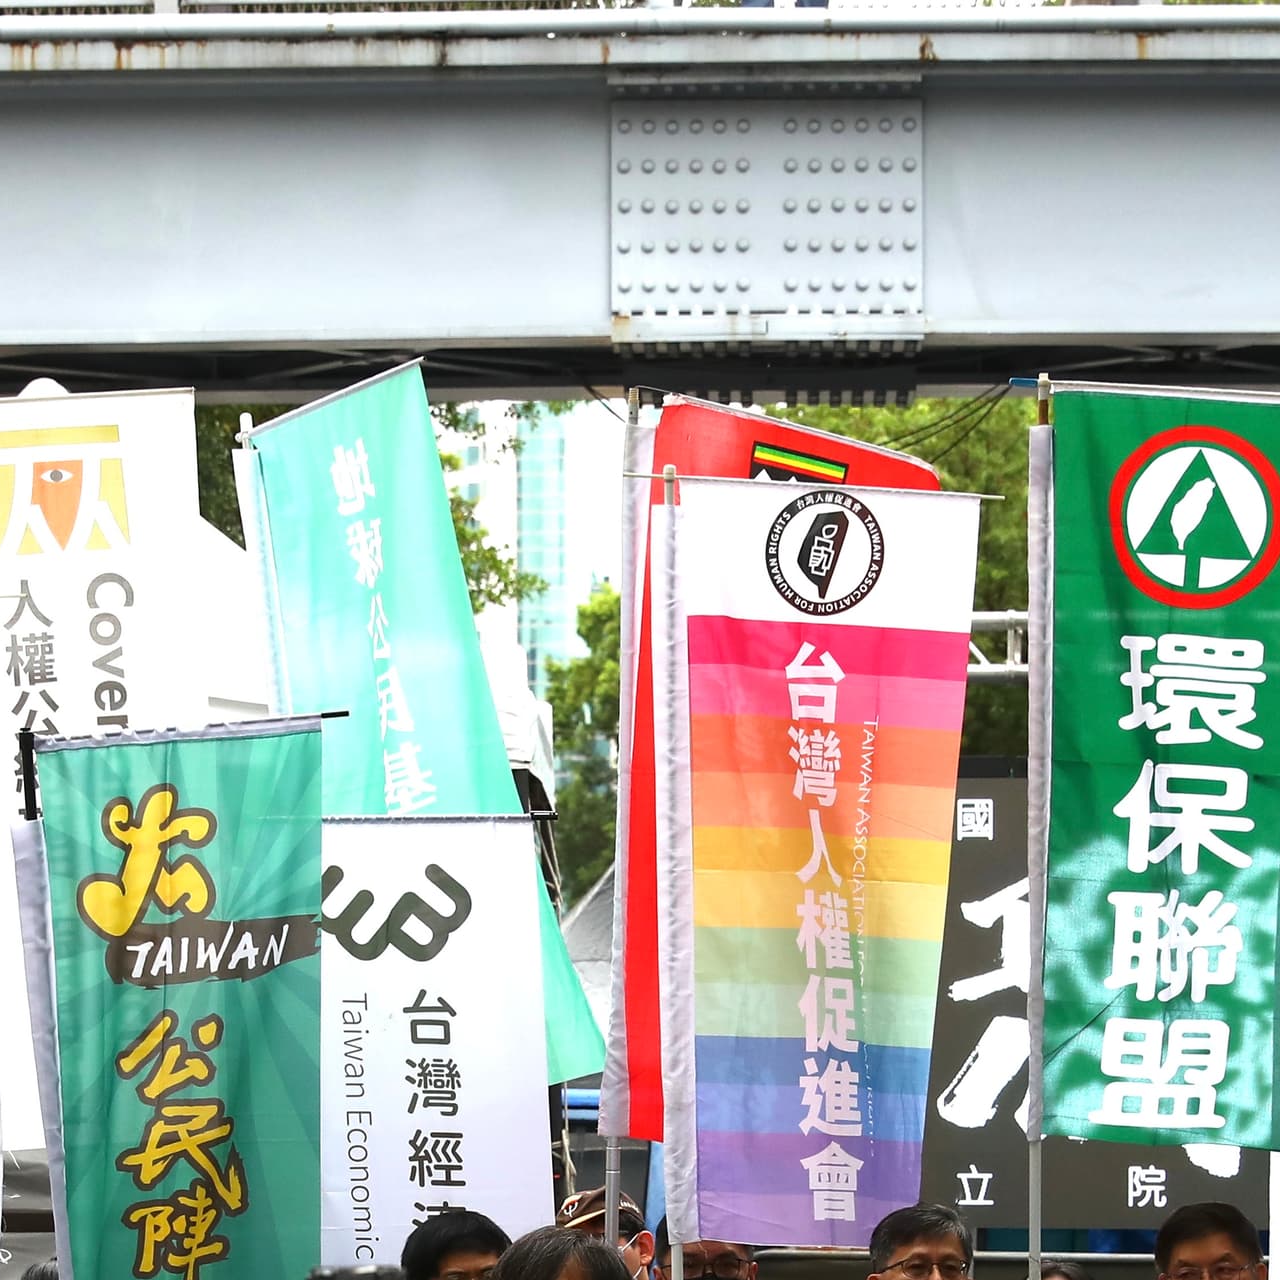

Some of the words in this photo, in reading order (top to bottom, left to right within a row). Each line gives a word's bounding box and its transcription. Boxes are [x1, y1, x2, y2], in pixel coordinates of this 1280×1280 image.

[768, 511, 792, 554] RIGHTS
[863, 514, 881, 560] TAIWAN
[768, 558, 795, 599] HUMAN
[817, 562, 880, 613] ASSOCIATION
[794, 599, 814, 612] FOR
[857, 715, 880, 803] TAIWAN
[956, 798, 994, 841] 國
[1088, 634, 1267, 1131] 環保聯盟
[126, 920, 290, 980] TAIWAN
[784, 641, 865, 1222] 台灣人權促進會
[341, 992, 370, 1099] Taiwan
[346, 1110, 376, 1260] Economic
[957, 1164, 994, 1206] 立
[1127, 1165, 1167, 1208] 院
